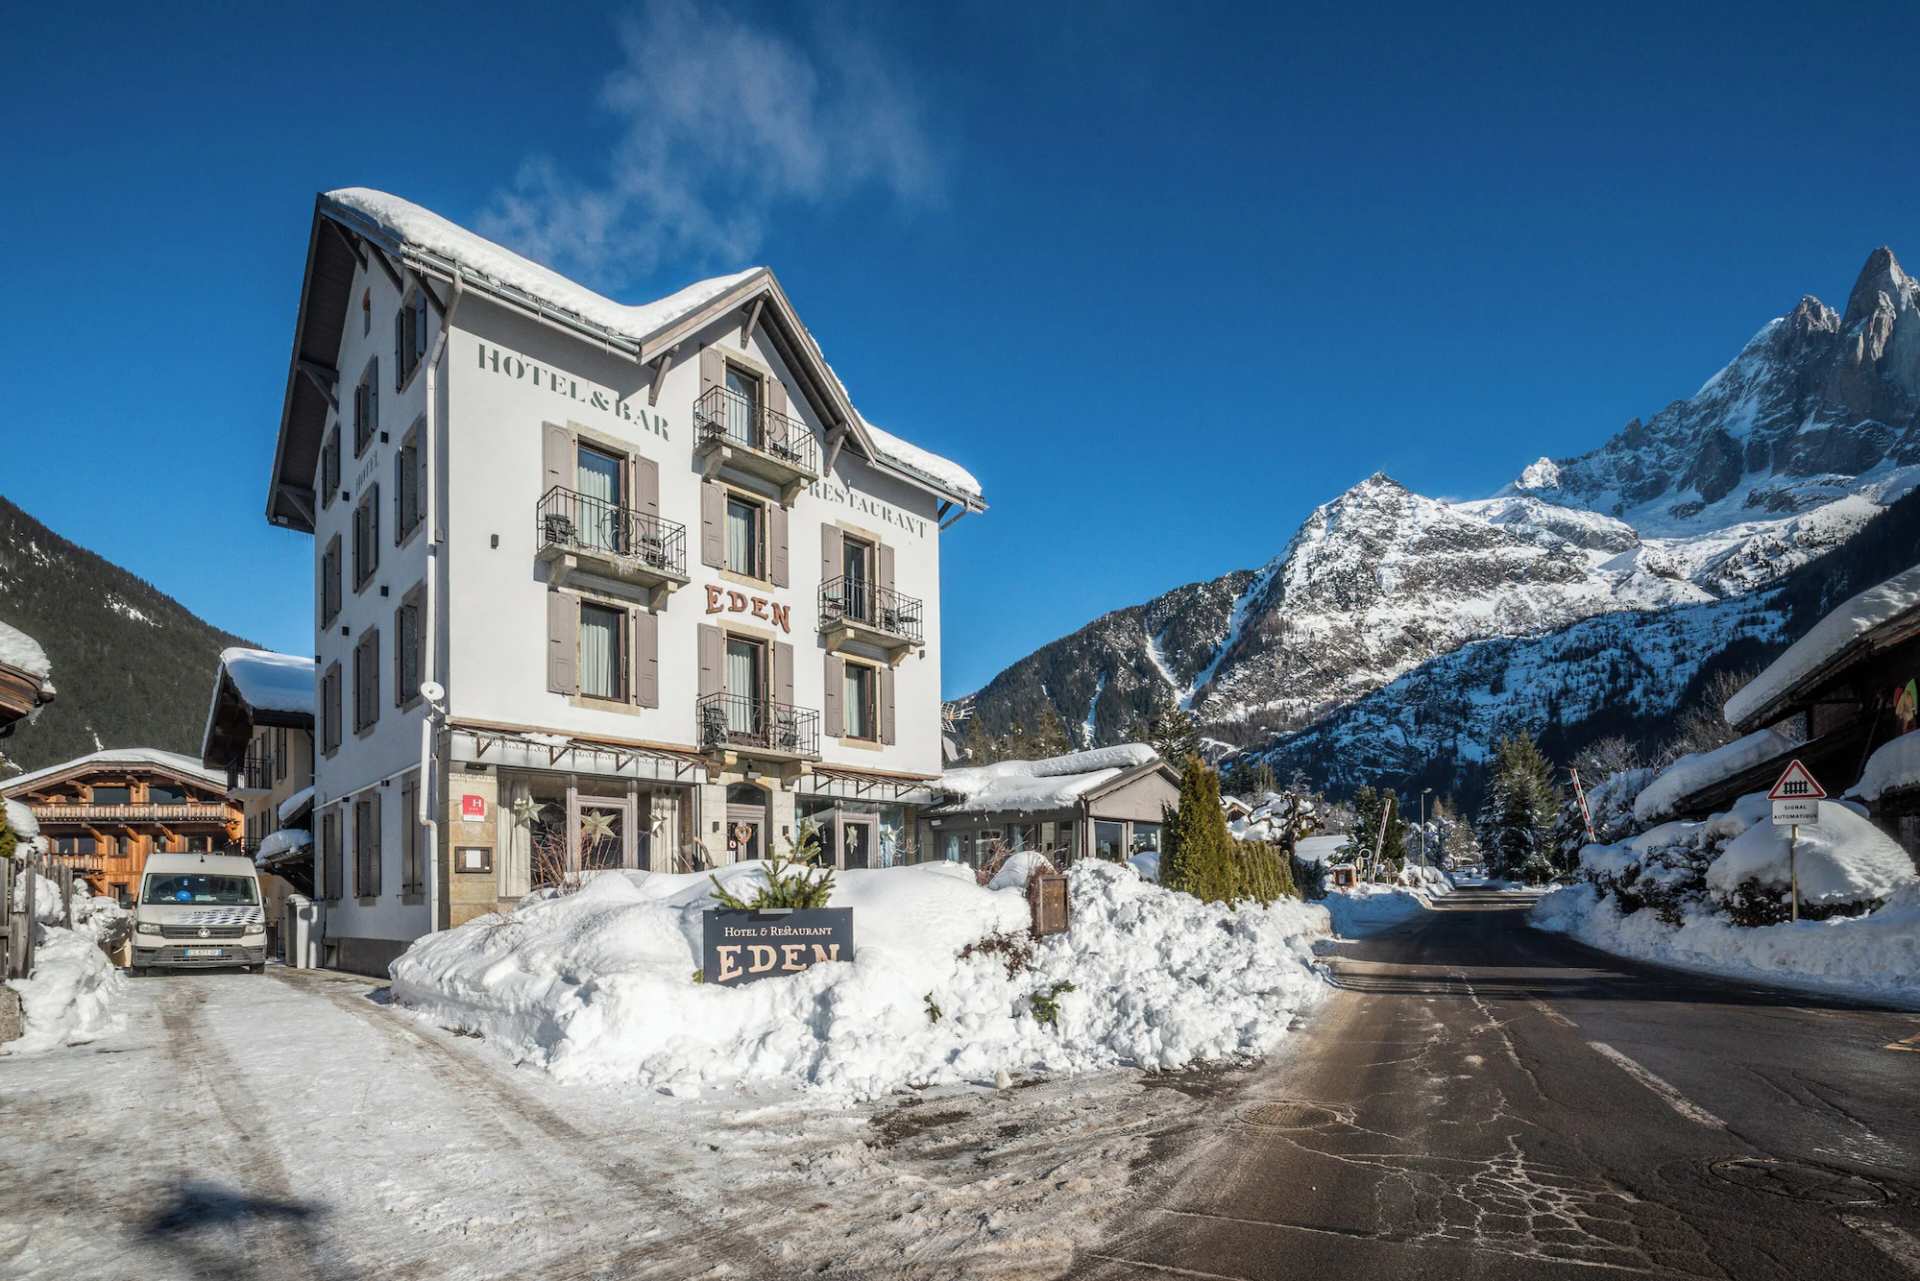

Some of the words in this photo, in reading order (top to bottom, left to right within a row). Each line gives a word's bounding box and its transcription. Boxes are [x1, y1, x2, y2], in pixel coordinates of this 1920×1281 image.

[809, 481, 927, 538] RESTAURANT
[704, 584, 791, 634] EDEN
[716, 943, 840, 982] EDEN
